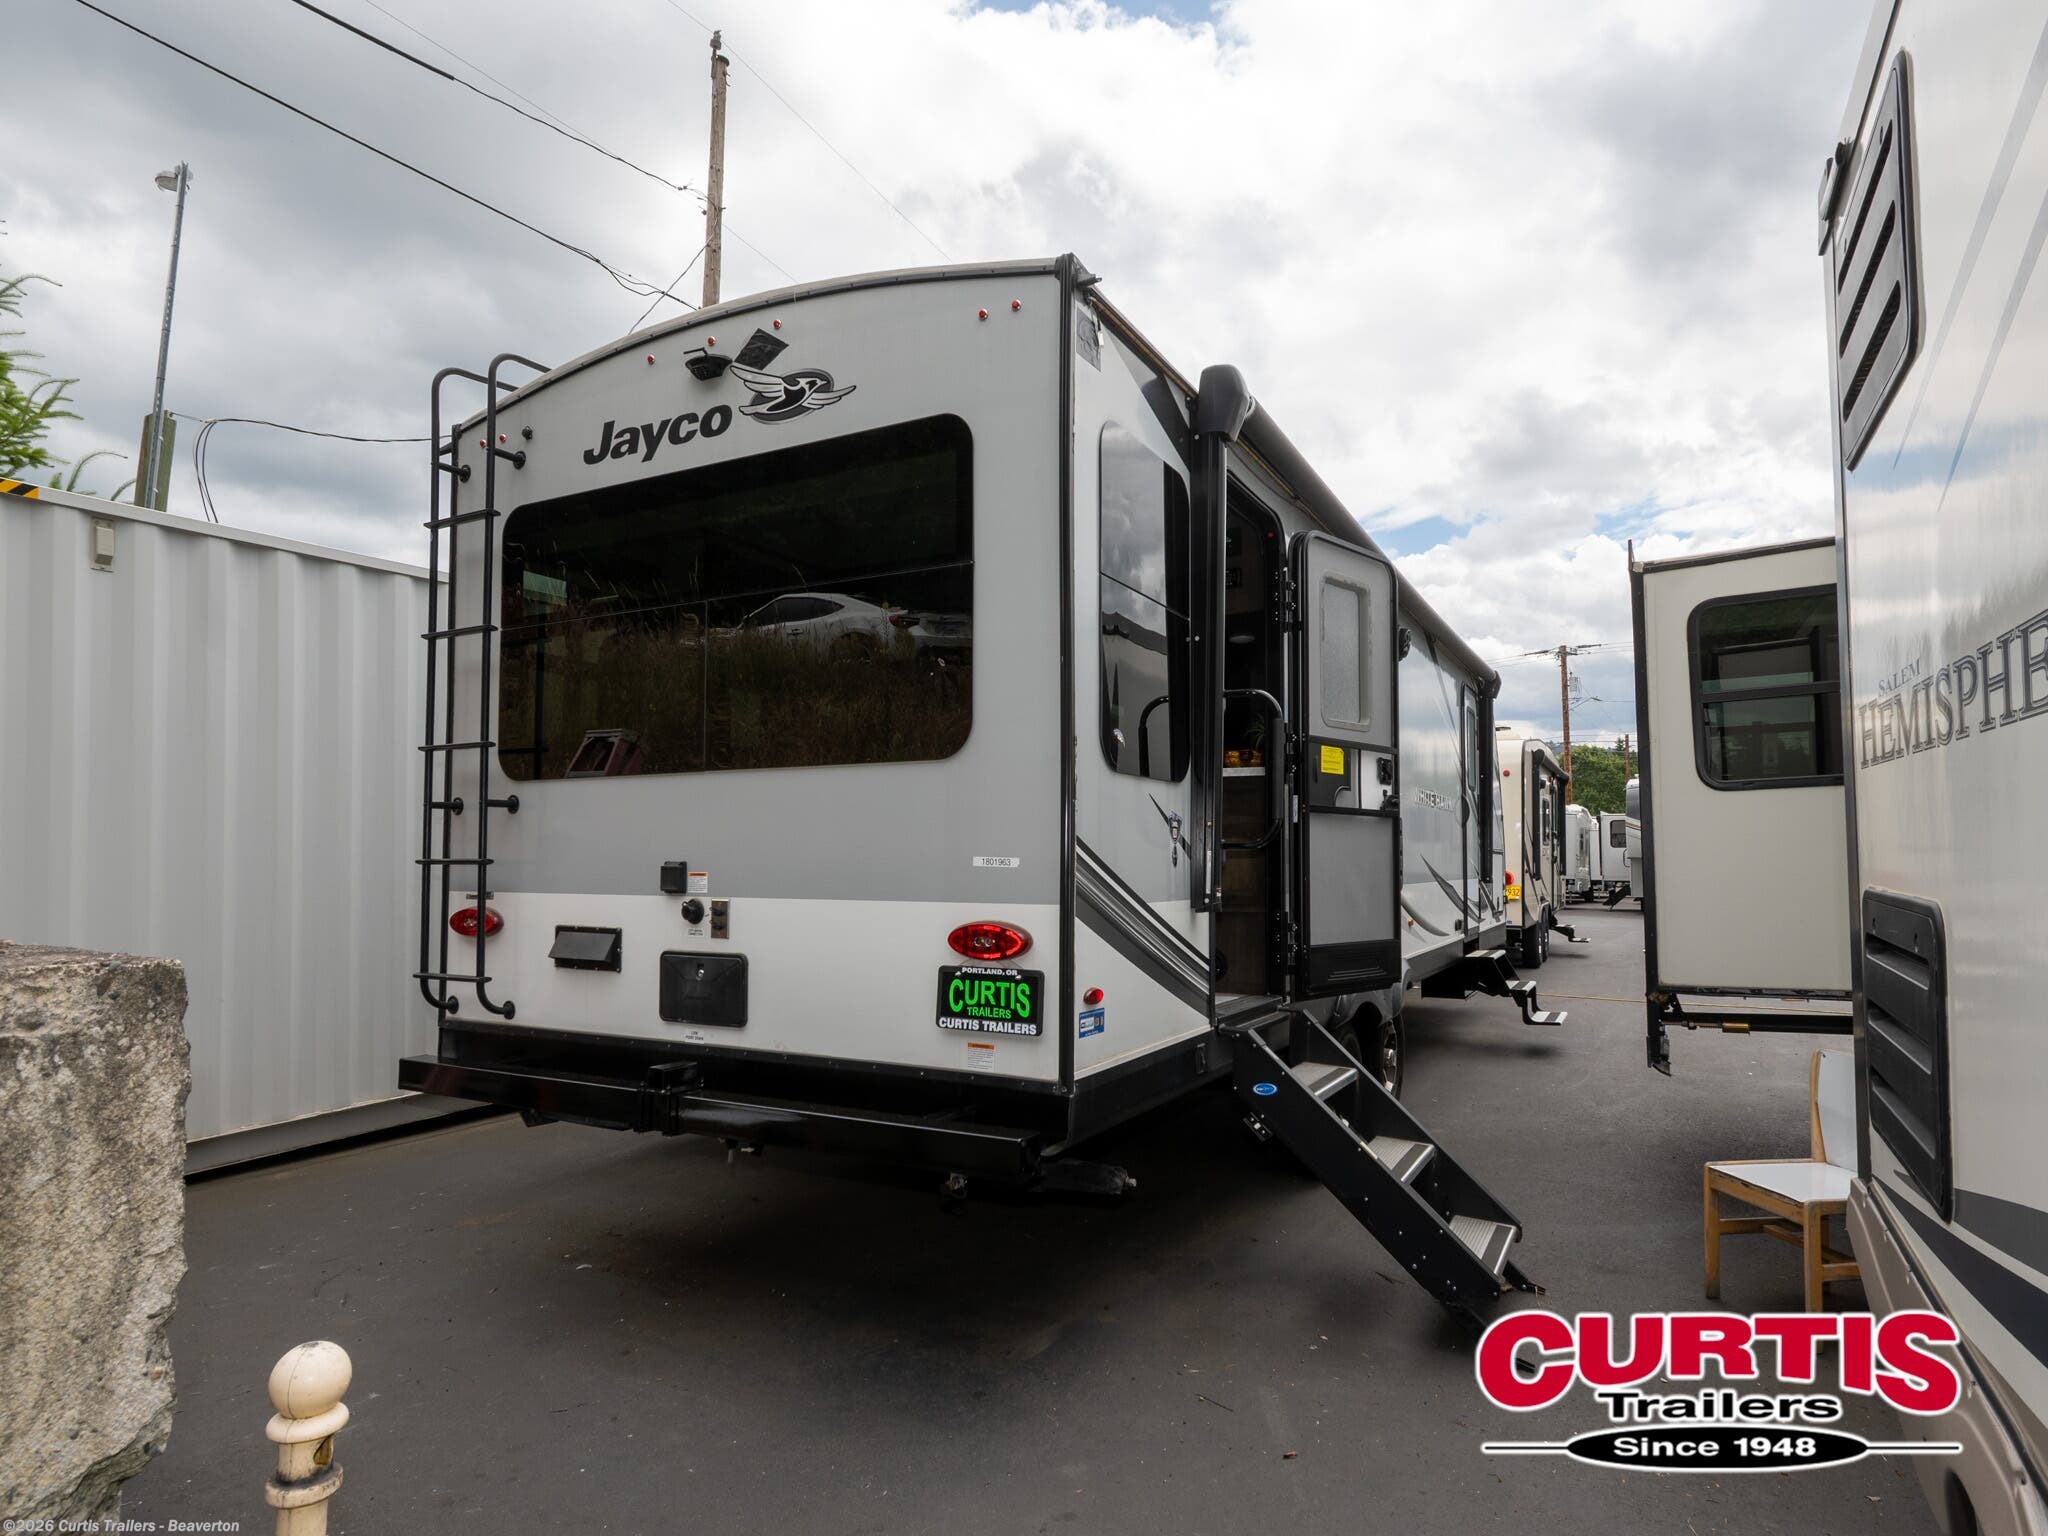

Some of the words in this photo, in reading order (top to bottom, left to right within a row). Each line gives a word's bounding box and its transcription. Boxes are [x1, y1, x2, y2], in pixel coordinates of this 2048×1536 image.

[583, 404, 733, 465] Jayco
[1878, 657, 1921, 697] SALEM
[949, 978, 1031, 1018] CURTIS
[967, 1006, 1012, 1019] TRAILERS
[939, 1017, 980, 1031] CURTIS
[982, 1020, 1037, 1035] TRAILERS
